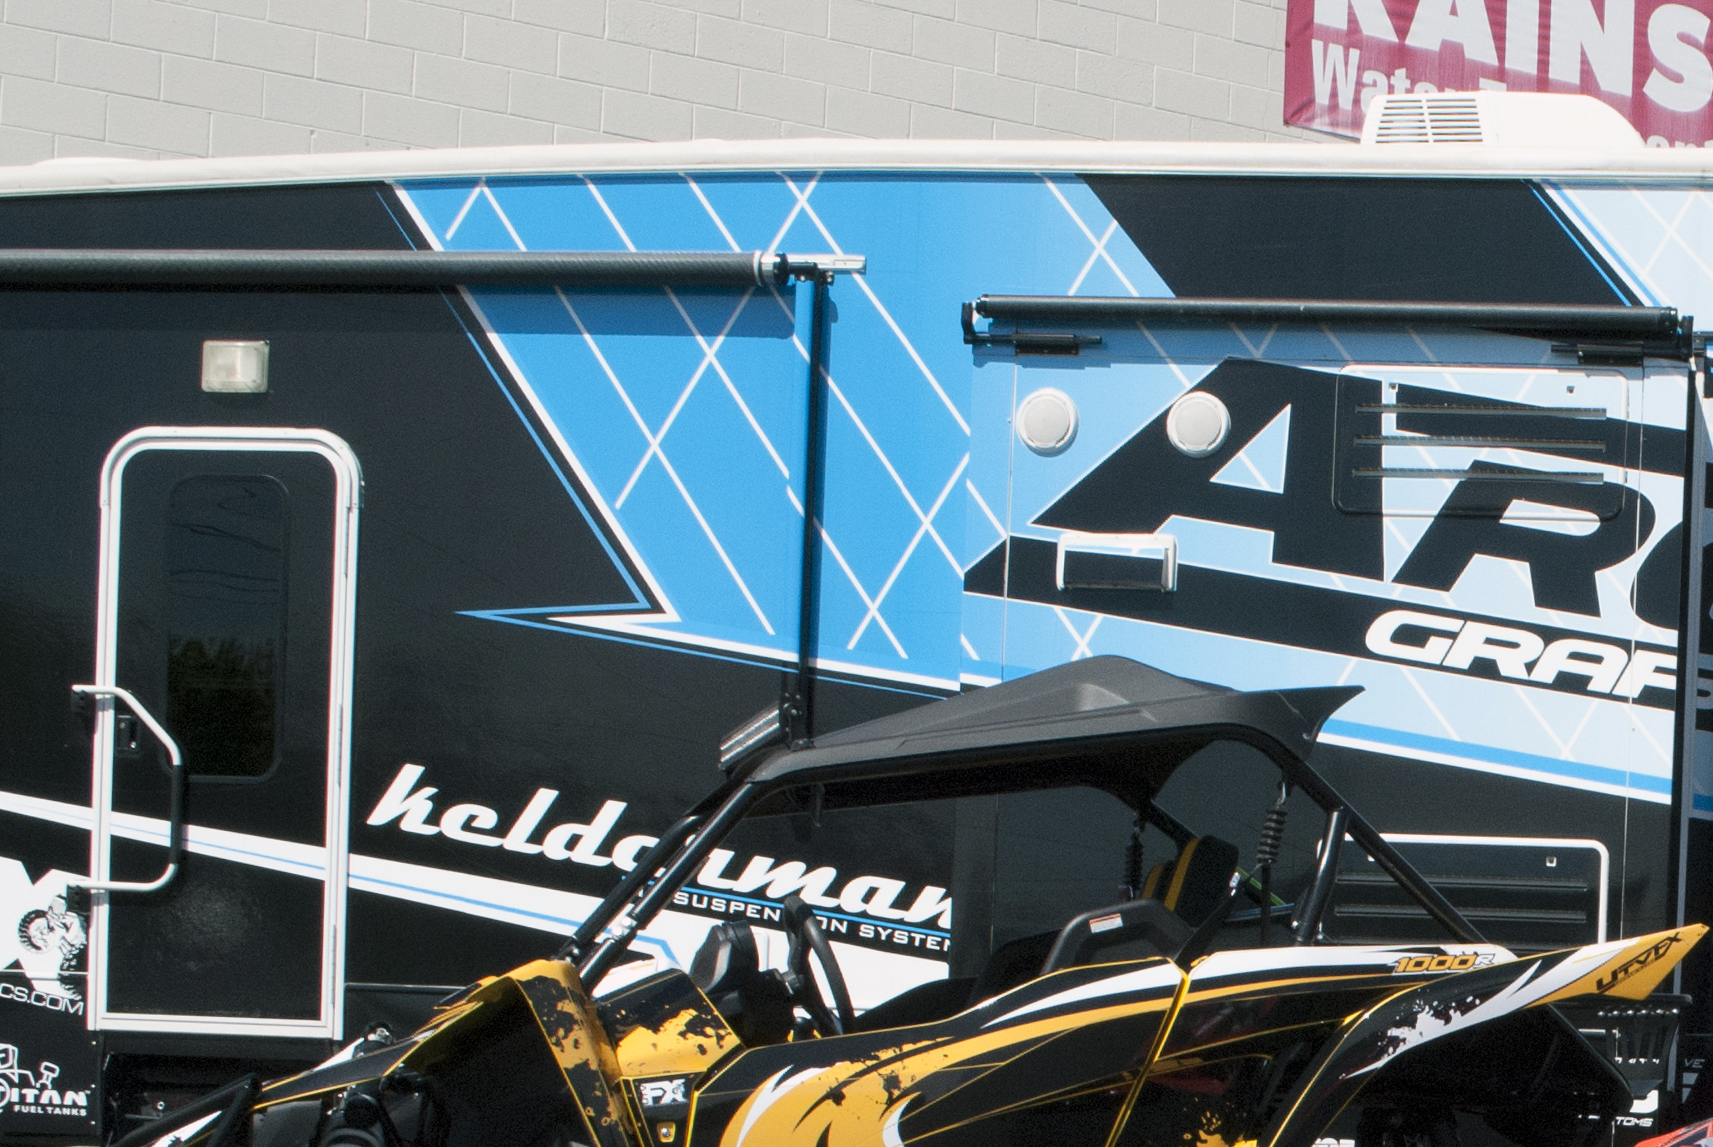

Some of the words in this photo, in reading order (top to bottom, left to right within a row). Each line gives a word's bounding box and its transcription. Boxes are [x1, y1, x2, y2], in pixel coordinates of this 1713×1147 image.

[673, 891, 828, 934] SUSPENN
[1393, 953, 1496, 974] 1000R
[0, 1086, 88, 1106] ITAN
[14, 1104, 44, 1114] FUEL
[45, 1106, 87, 1117] TANKS
[1616, 1116, 1654, 1127] TOMS
